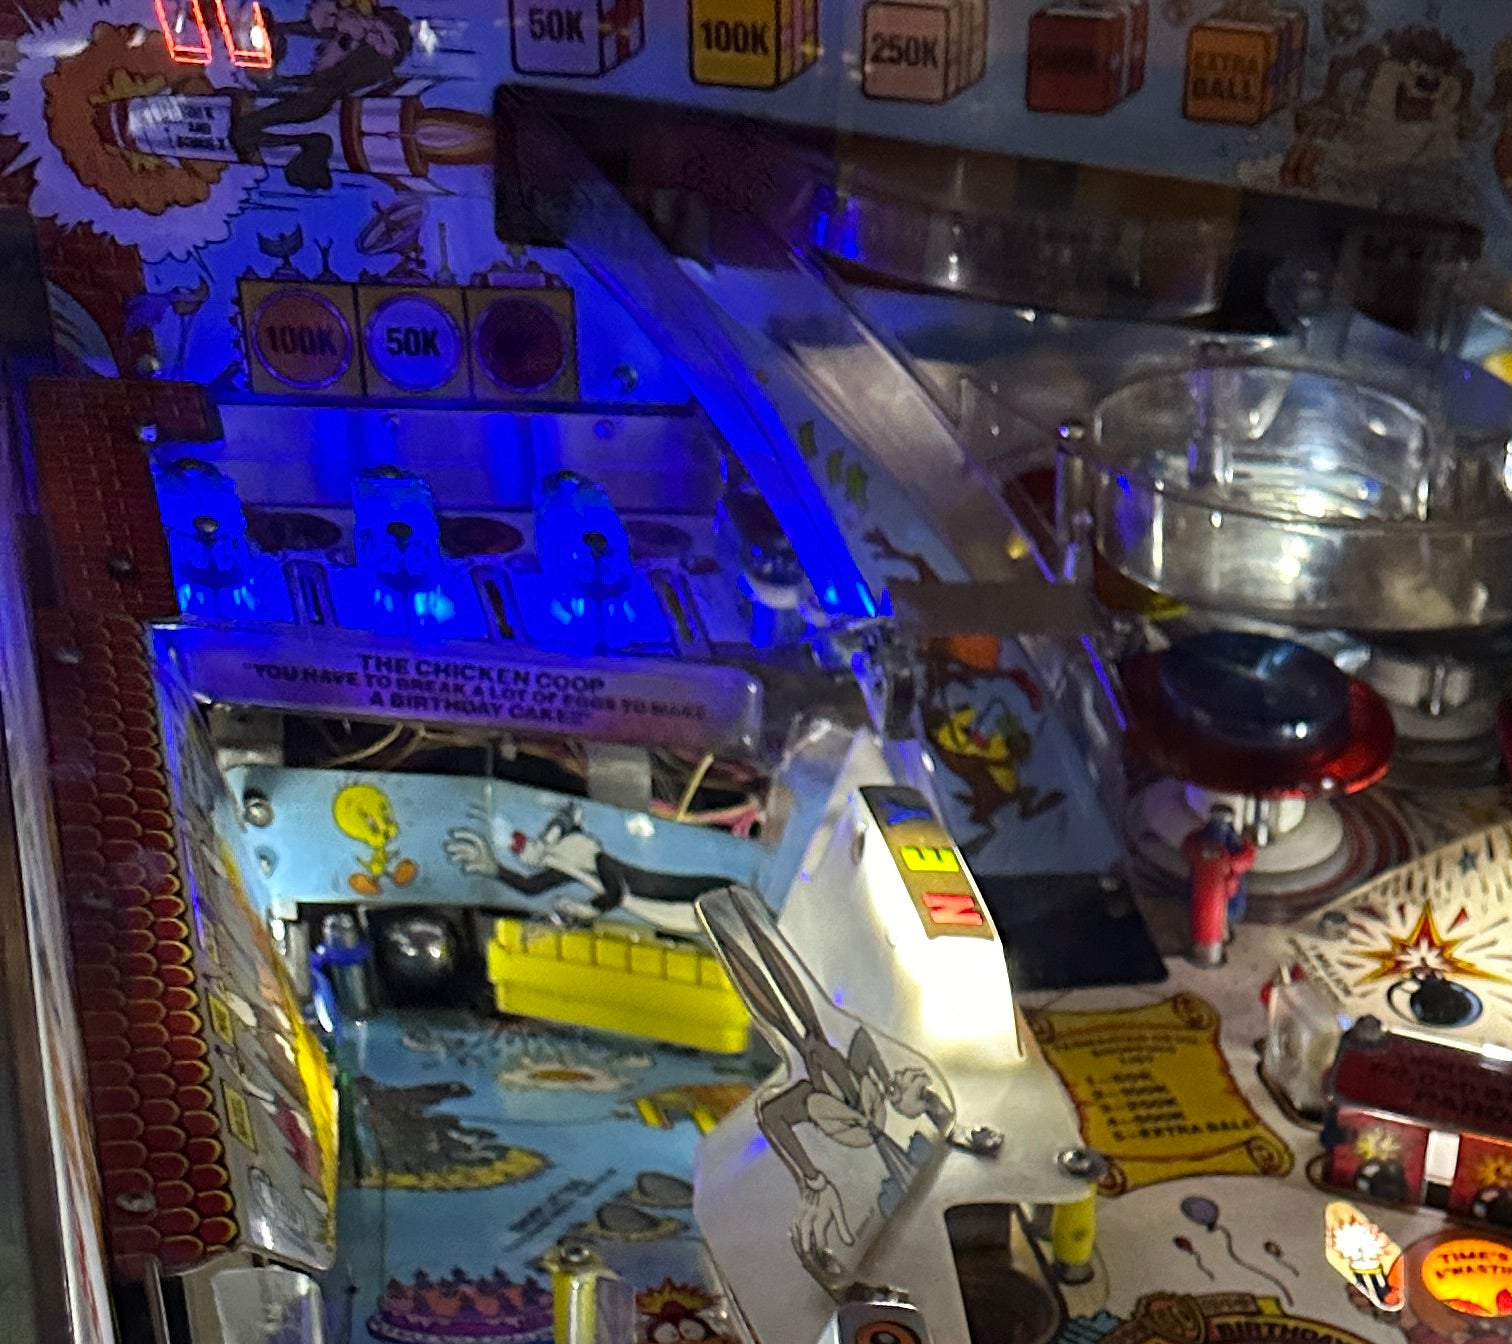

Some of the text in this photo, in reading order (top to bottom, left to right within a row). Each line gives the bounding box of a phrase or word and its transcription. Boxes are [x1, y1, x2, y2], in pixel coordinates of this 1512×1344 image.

[528, 7, 586, 43] 50K
[701, 19, 769, 56] 100K
[871, 32, 938, 69] 250K
[386, 326, 442, 356] 50K
[360, 654, 605, 692] THE CHICKEN COOP
